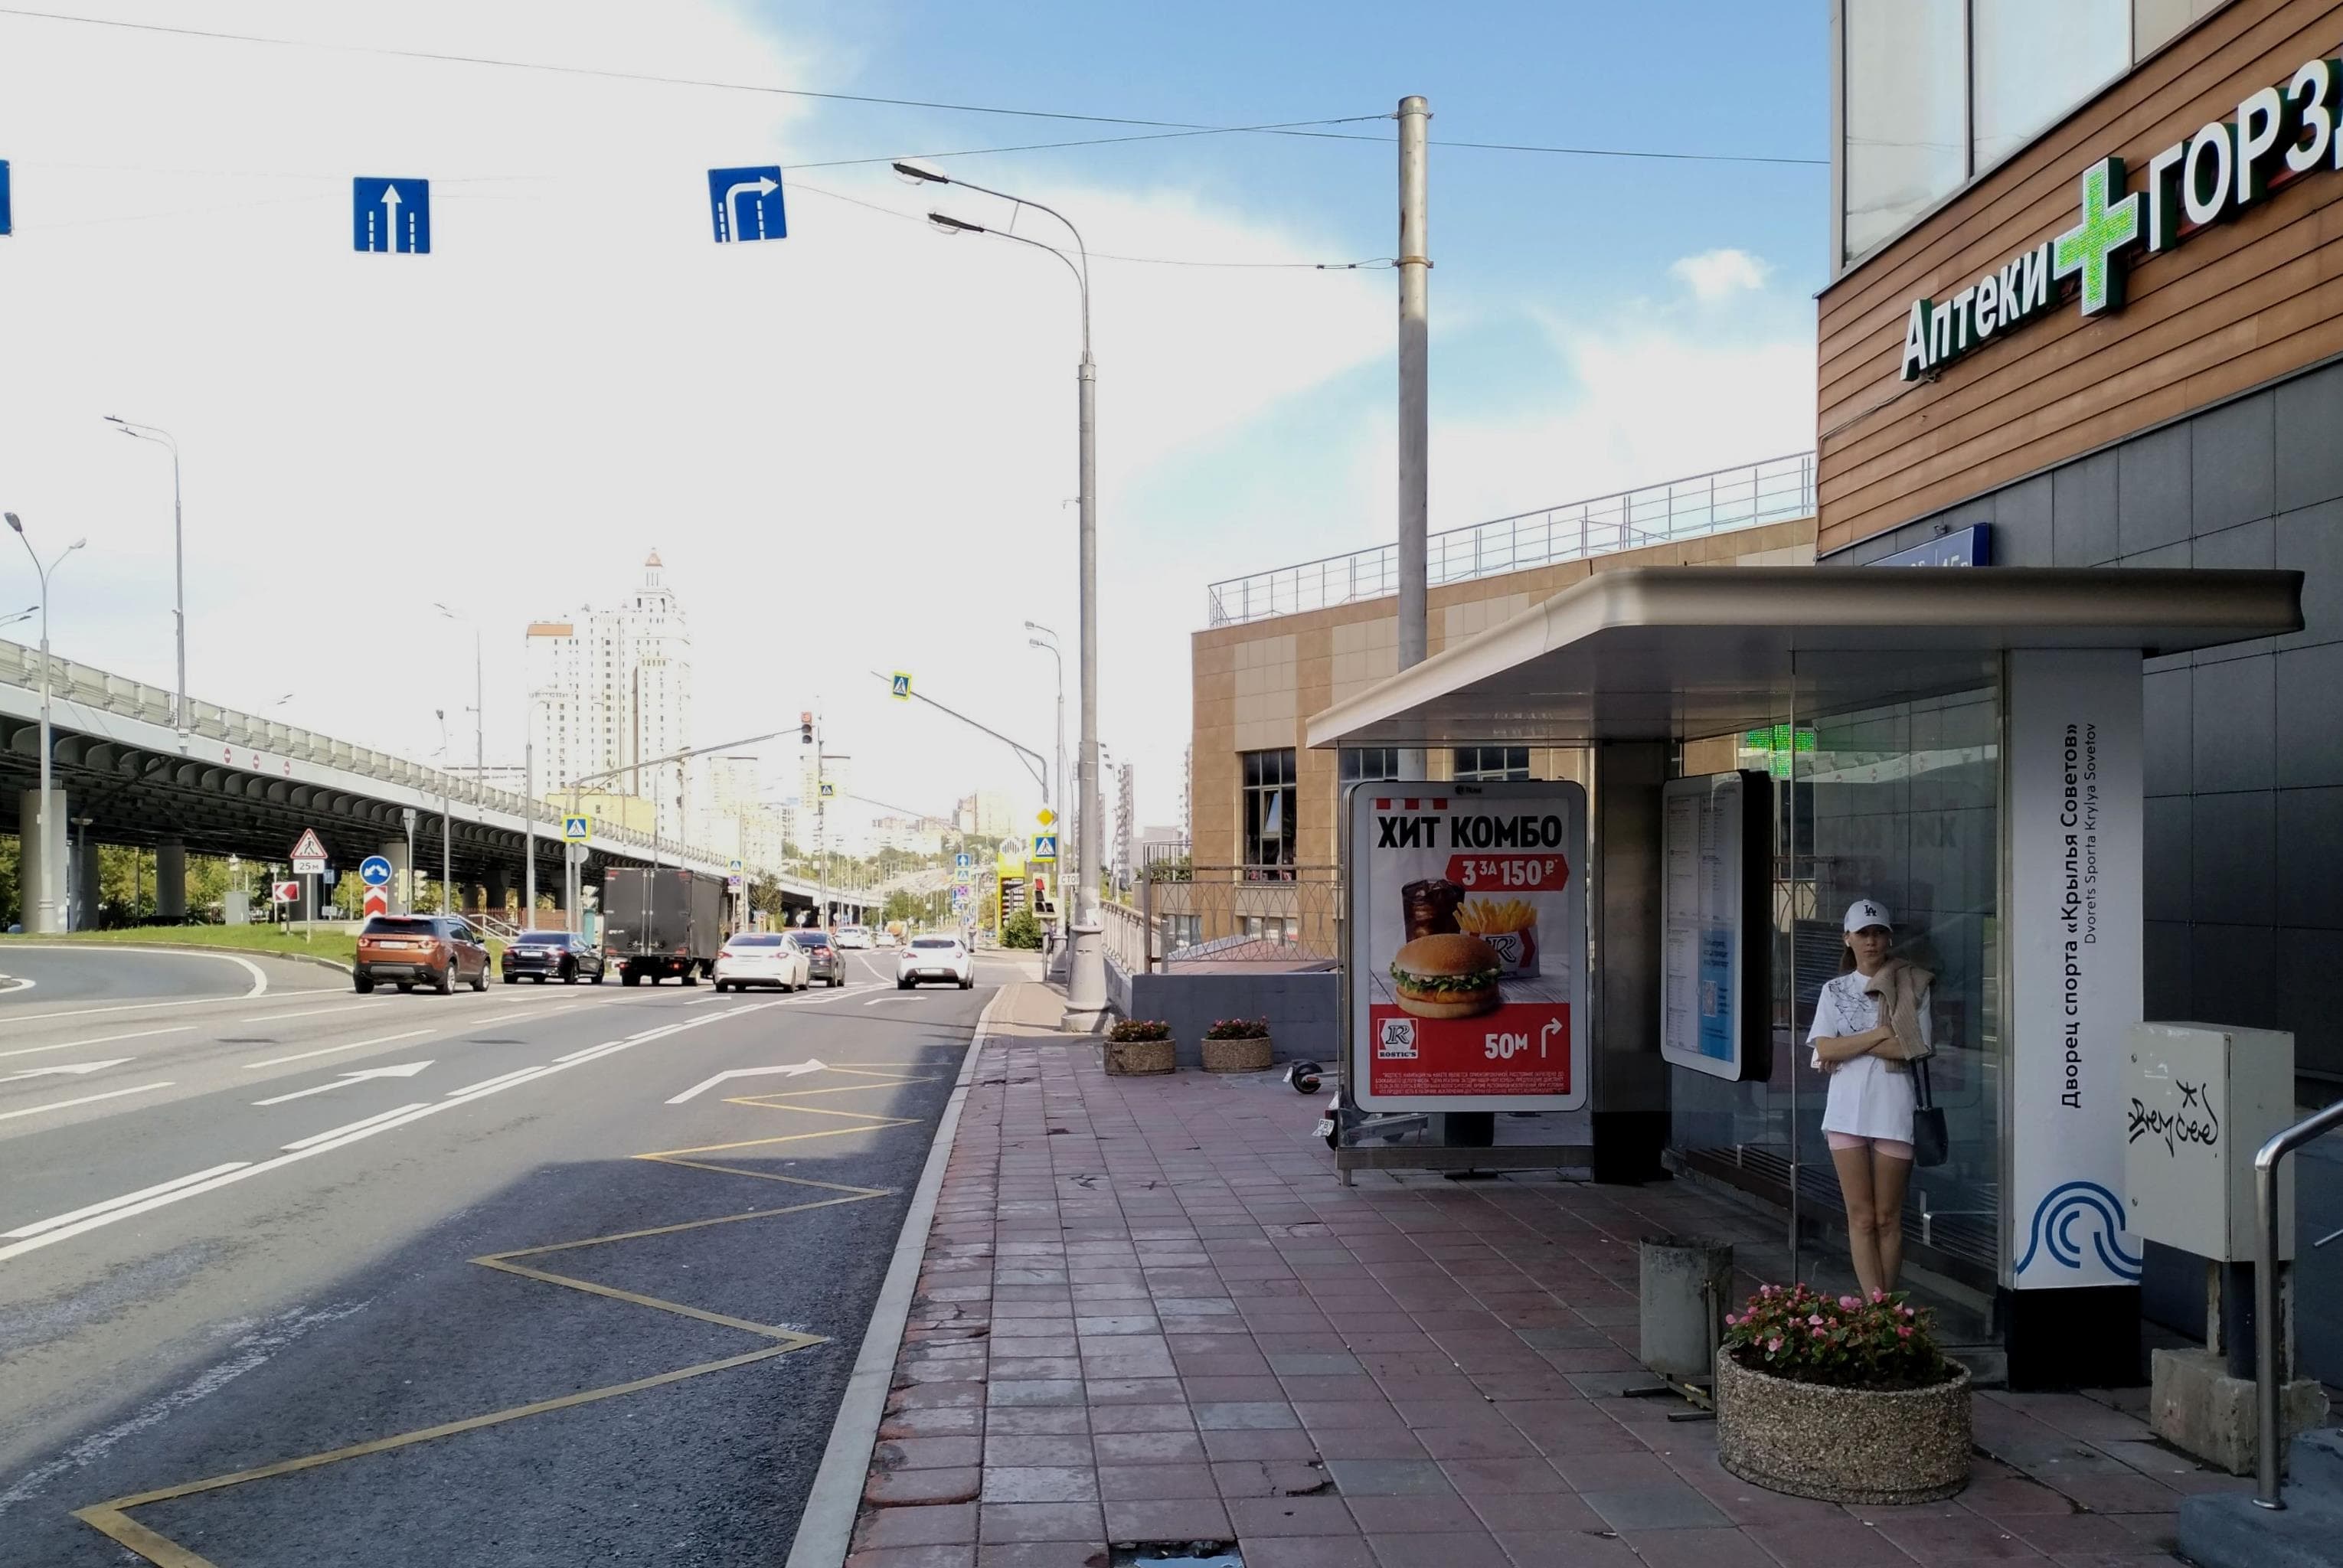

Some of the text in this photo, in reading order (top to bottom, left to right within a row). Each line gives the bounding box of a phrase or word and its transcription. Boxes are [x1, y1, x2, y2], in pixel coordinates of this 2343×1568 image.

[2149, 59, 2343, 252] ГОРЗ
[1900, 242, 2048, 381] Аптеки
[1377, 815, 1563, 848] ХИТ КОМБО
[1462, 861, 1476, 886] 3
[1501, 861, 1542, 886] 150
[2083, 724, 2099, 943] Dvorets Sporta Krylya Sovetov
[1864, 905, 1877, 916] LA
[2060, 724, 2082, 1108] Дворец спорта «Крылья Советов»
[1385, 1024, 1410, 1044] R
